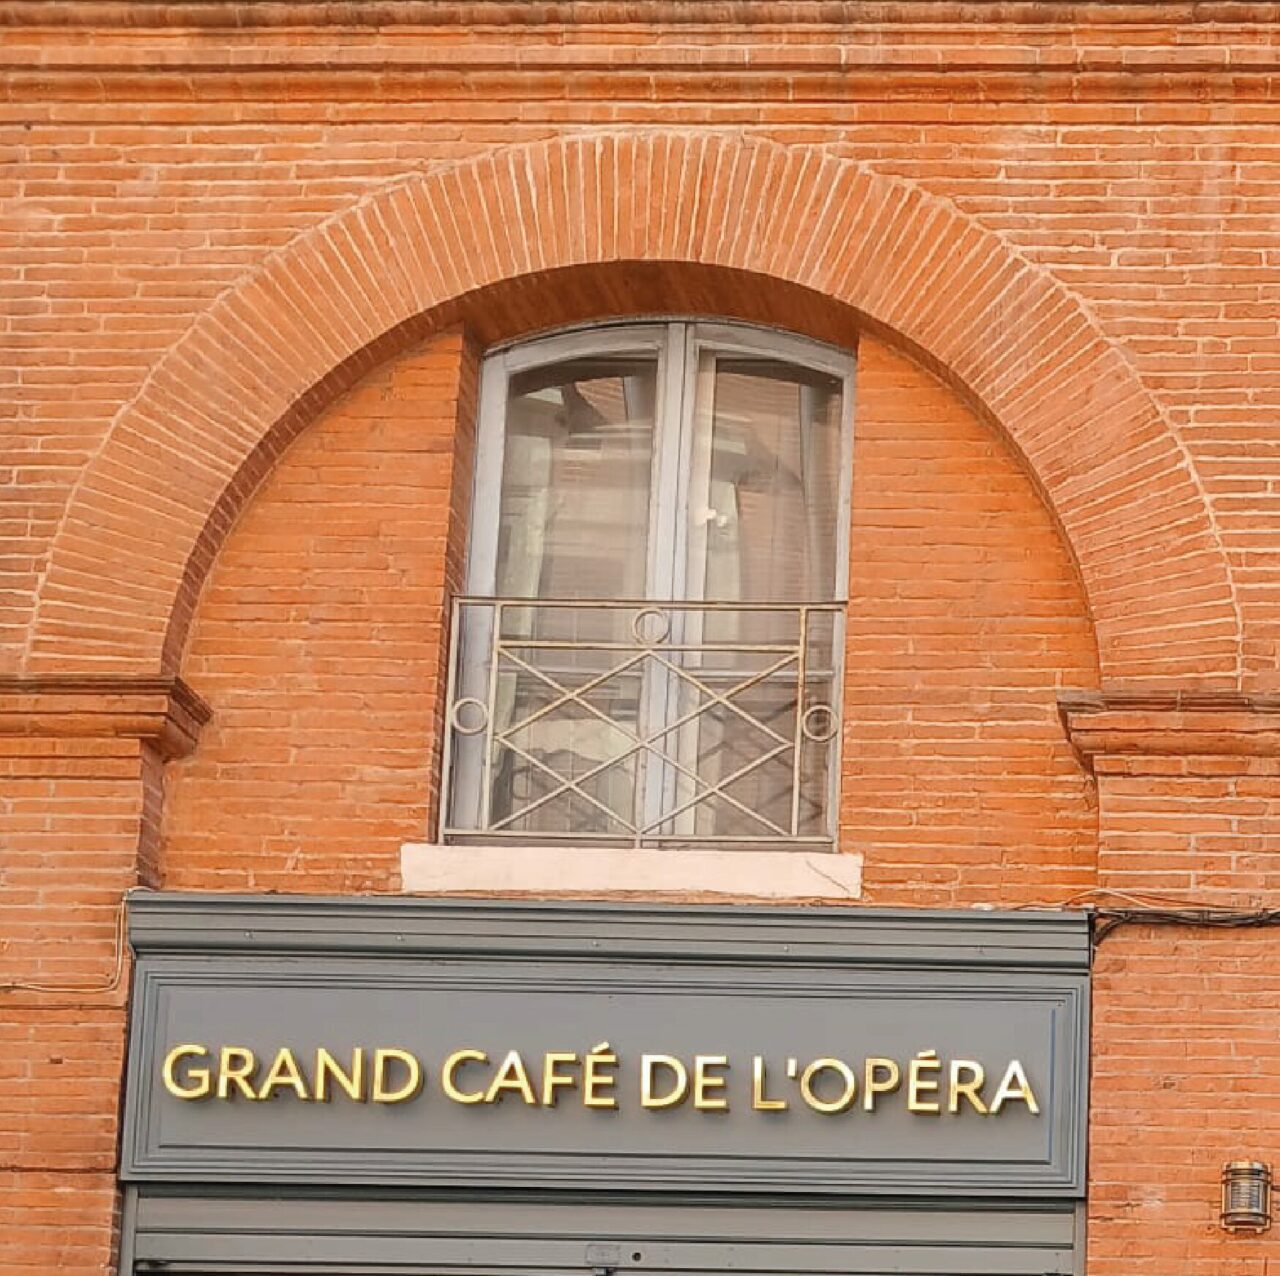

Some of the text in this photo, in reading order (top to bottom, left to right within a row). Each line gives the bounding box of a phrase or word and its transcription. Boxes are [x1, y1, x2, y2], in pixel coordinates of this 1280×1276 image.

[162, 1041, 1040, 1114] GRAND CAFÉ DE L'OPÉRA
